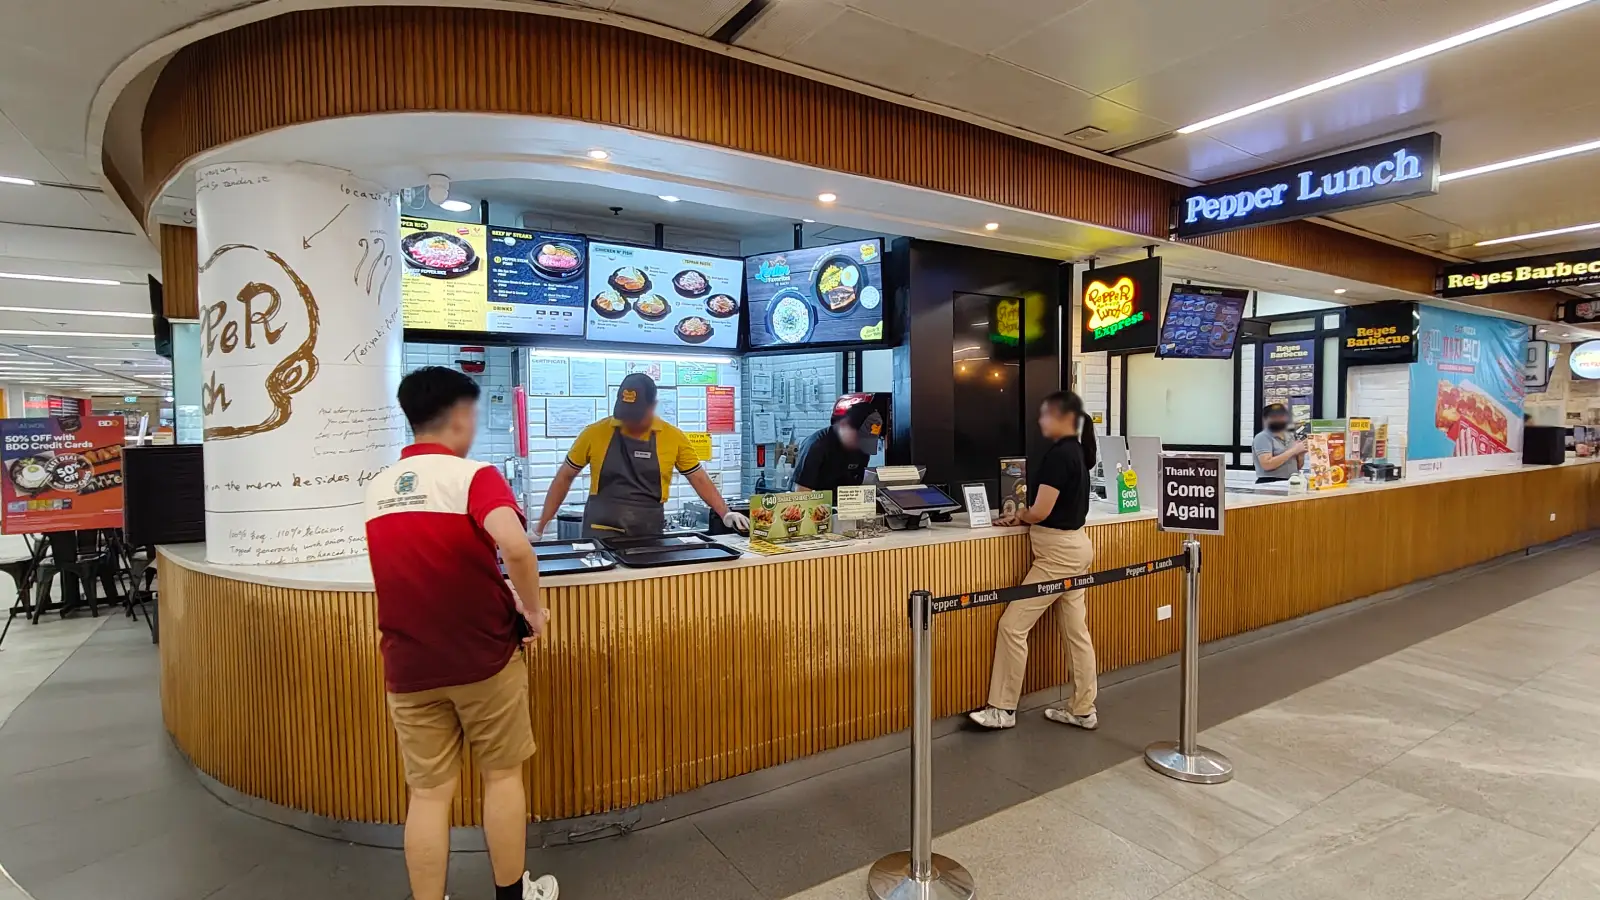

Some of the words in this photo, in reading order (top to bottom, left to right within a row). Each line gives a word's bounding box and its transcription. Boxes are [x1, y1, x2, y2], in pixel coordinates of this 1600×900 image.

[1184, 182, 1288, 223] Pepper
[1296, 148, 1422, 201] Lunch
[1447, 270, 1513, 289] Reyes
[1515, 260, 1600, 282] Barbec
[1094, 311, 1144, 340] Express
[1357, 325, 1396, 338] Reyes
[344, 325, 385, 365] Teriyaki
[1346, 334, 1410, 348] Barbecue
[5, 435, 29, 443] 50%
[6, 443, 29, 451] BDO
[31, 441, 62, 449] Credit
[65, 440, 93, 449] Cards
[56, 461, 80, 478] 50%
[64, 472, 79, 482] OFF
[1165, 466, 1195, 477] Thank
[1198, 466, 1217, 477] You
[225, 480, 240, 491] the
[1167, 481, 1215, 498] Come
[1121, 489, 1136, 499] Grab
[1123, 498, 1137, 508] Food
[1166, 501, 1215, 521] Again
[256, 543, 298, 557] generously
[1125, 564, 1146, 577] Pepper
[1155, 558, 1173, 570] Lunch
[1037, 580, 1062, 594] Pepper
[1074, 575, 1094, 587] Lunch
[931, 598, 959, 612] epper
[973, 591, 998, 604] Lunch
